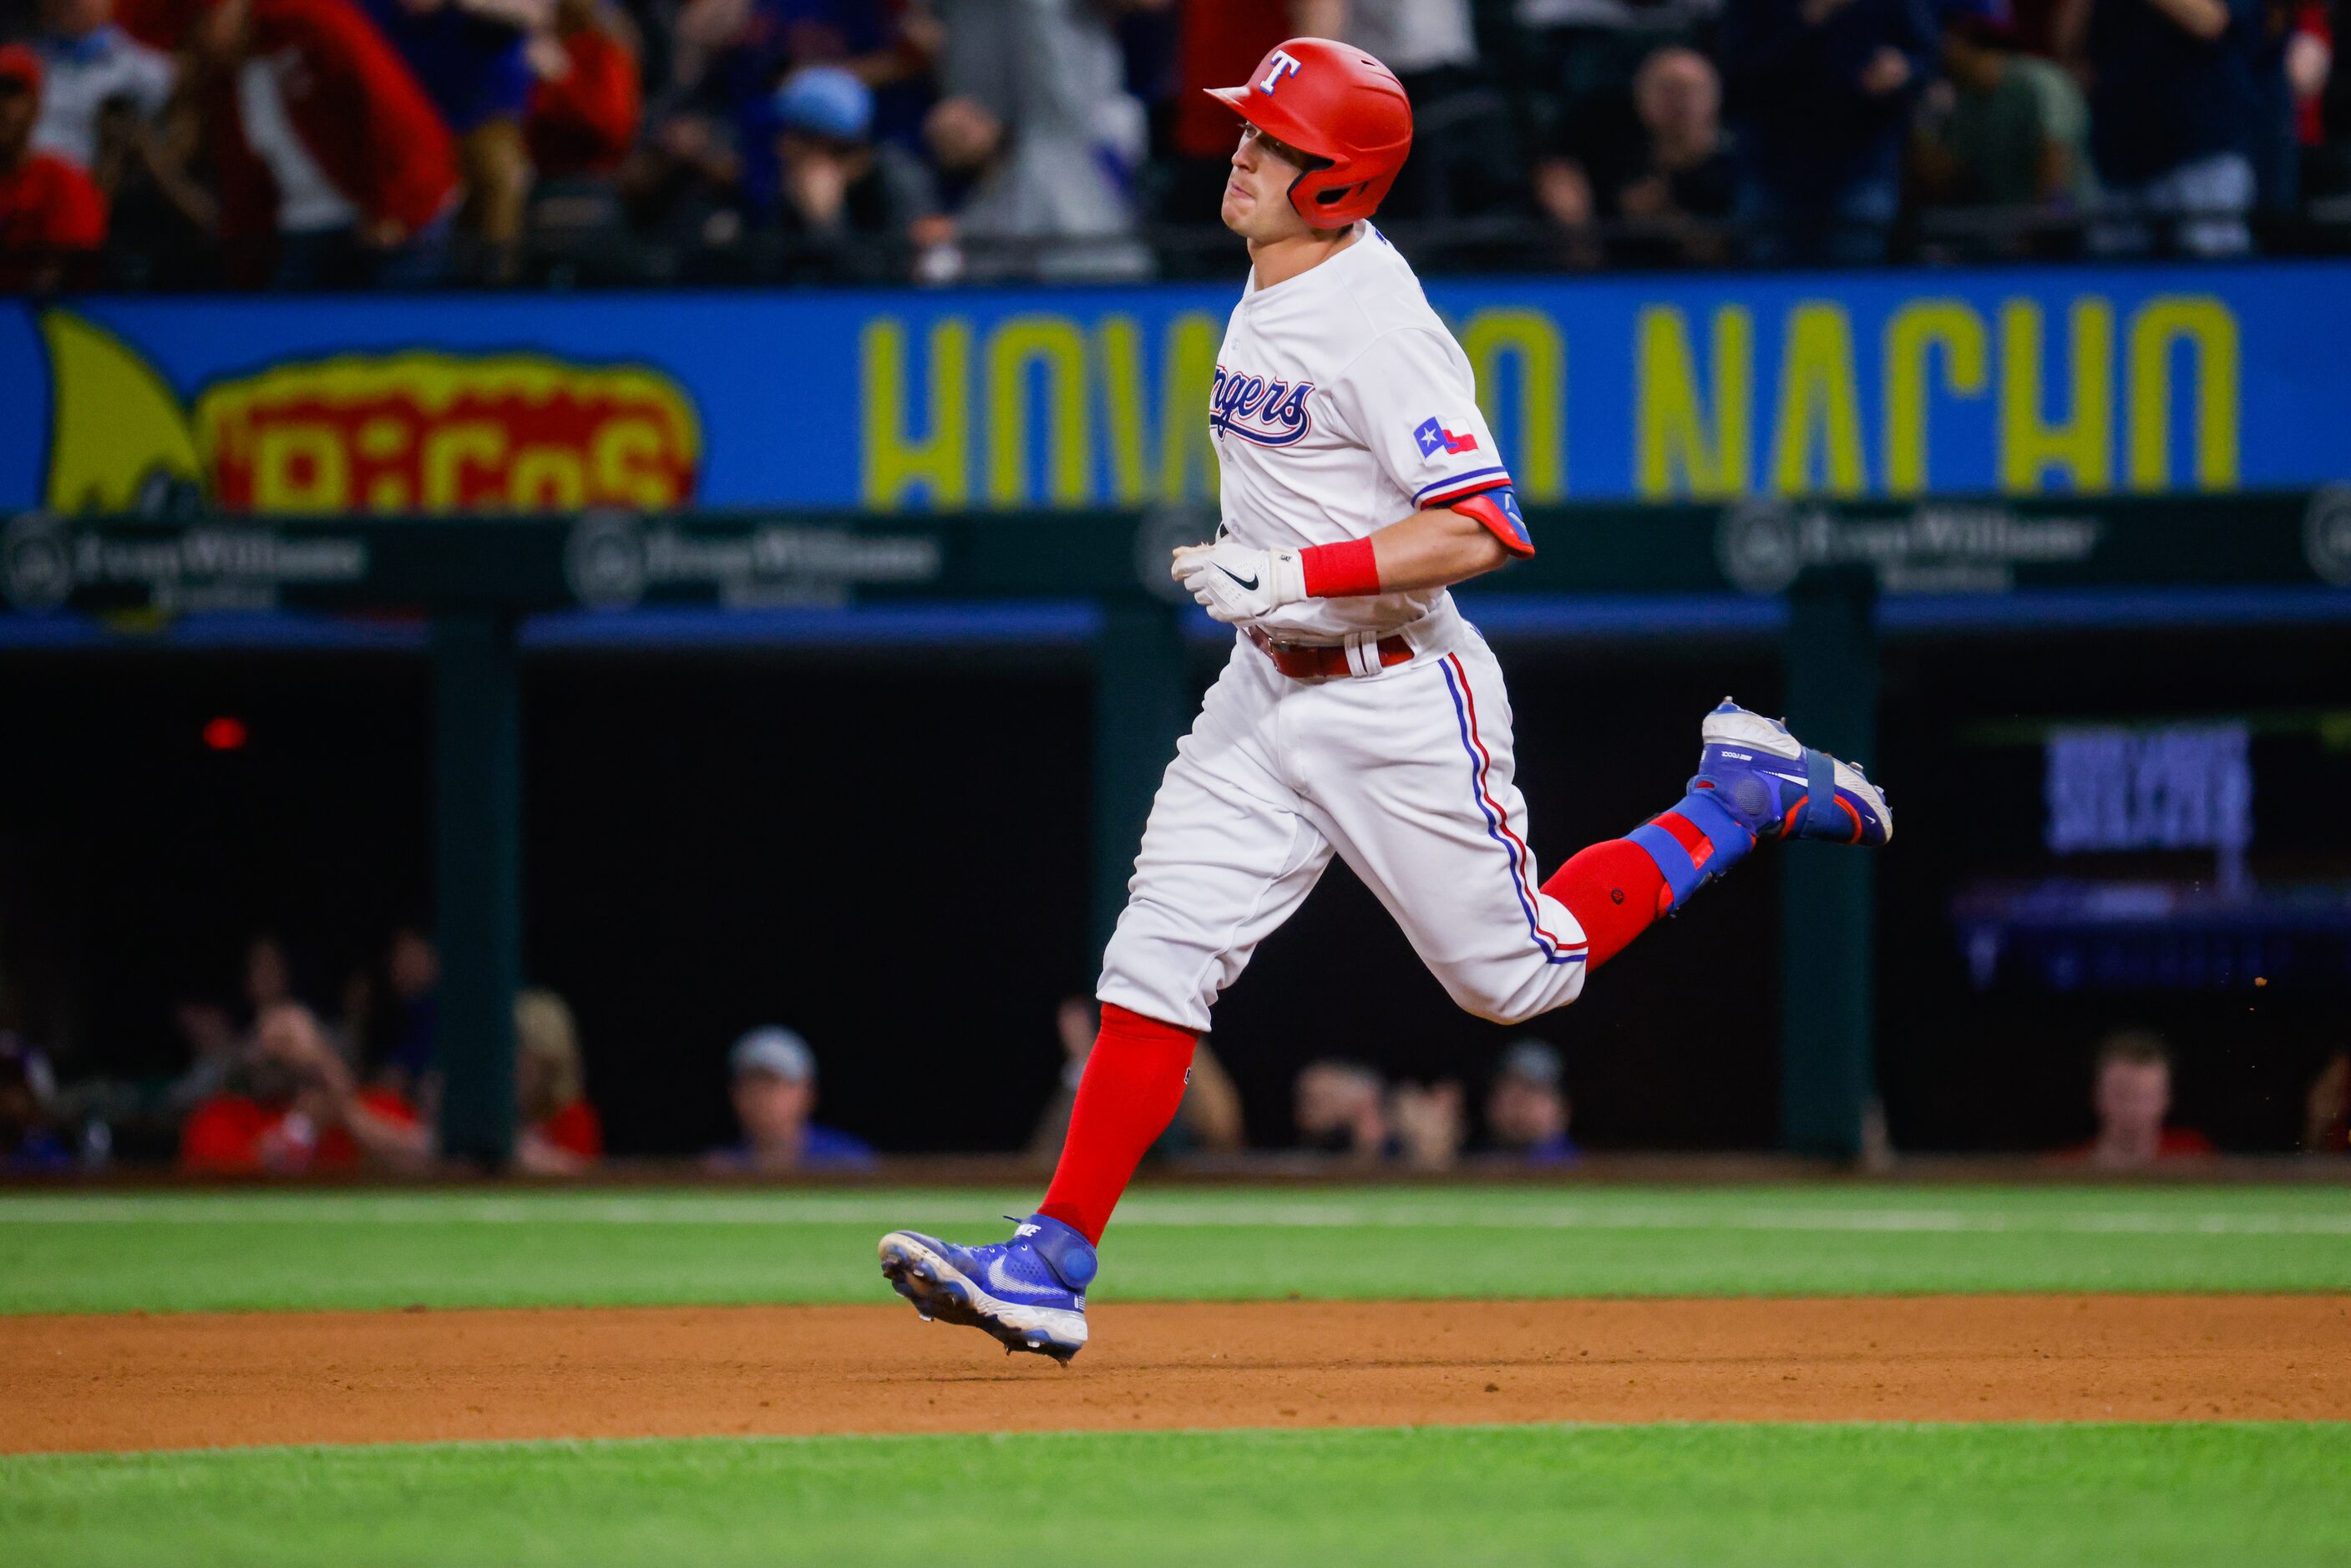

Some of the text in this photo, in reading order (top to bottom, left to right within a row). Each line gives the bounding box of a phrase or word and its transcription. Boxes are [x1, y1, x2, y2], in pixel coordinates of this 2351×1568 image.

[1259, 49, 1302, 97] T
[1457, 310, 1563, 504] O
[1637, 295, 2241, 495] NACHO
